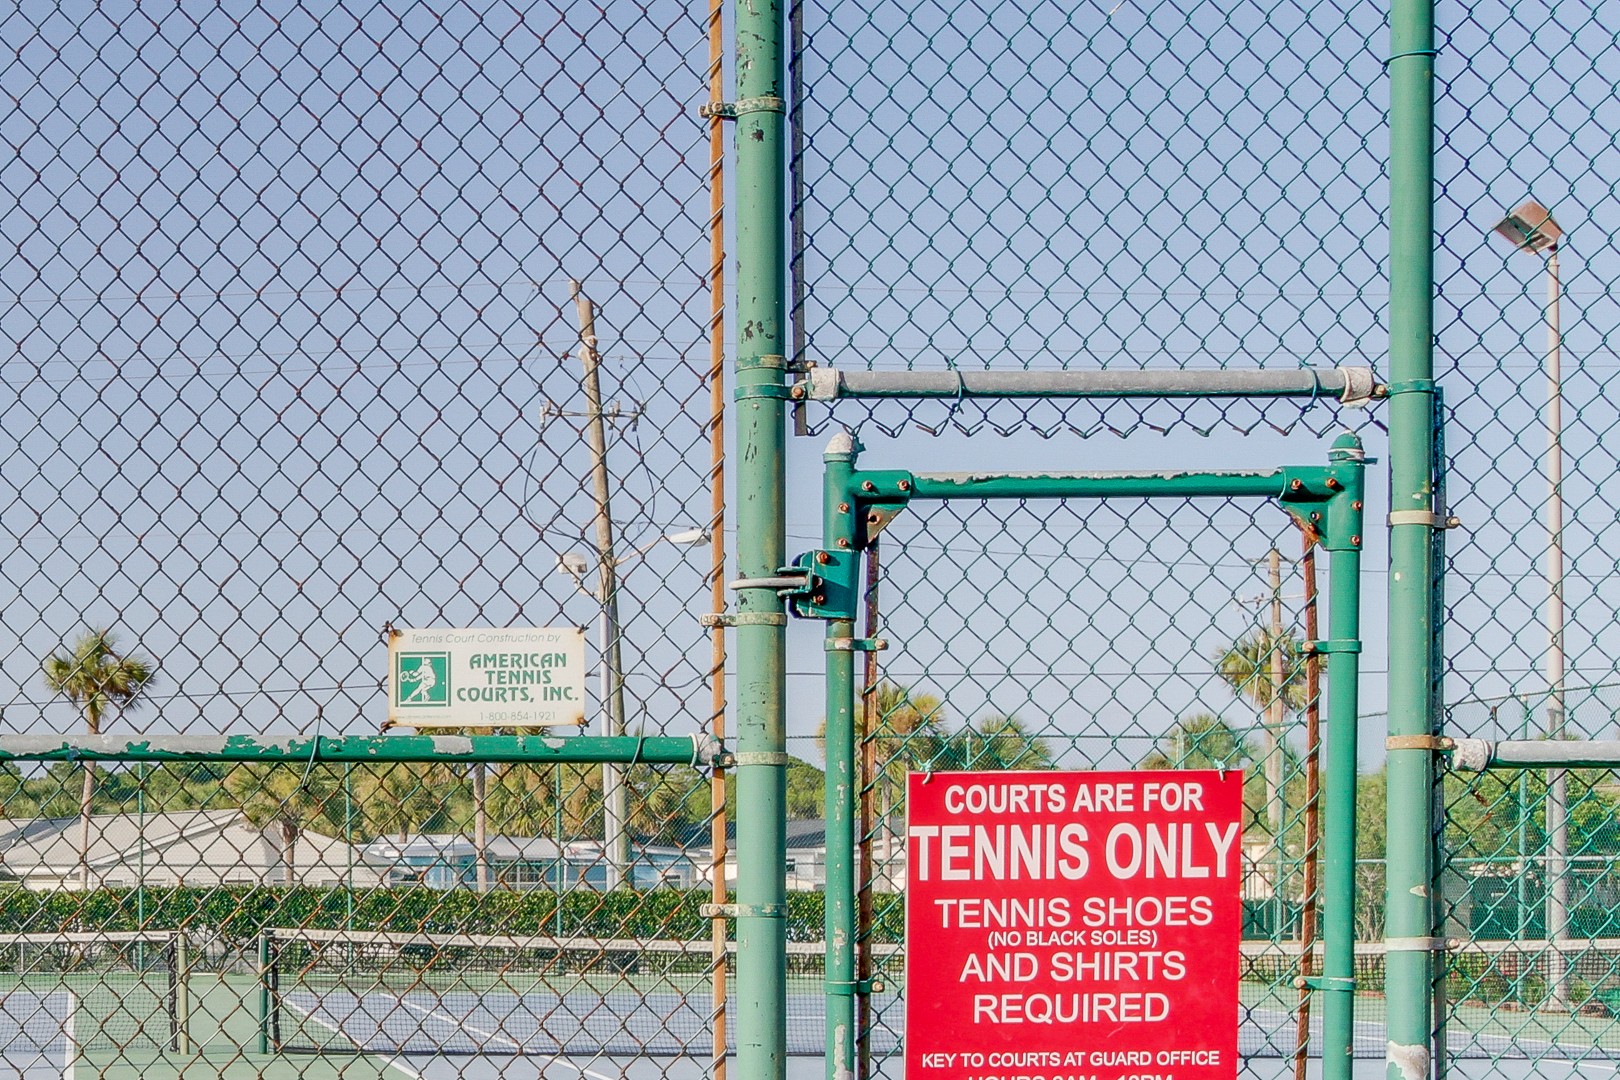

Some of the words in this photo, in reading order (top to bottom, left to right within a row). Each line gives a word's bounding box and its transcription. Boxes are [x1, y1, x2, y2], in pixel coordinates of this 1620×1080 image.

[411, 634, 443, 644] Tennis
[446, 634, 475, 643] Court
[477, 633, 544, 643] Construction
[547, 634, 561, 643] by
[470, 653, 567, 669] AMERICAN
[484, 670, 552, 685] TENNIS
[456, 687, 534, 703] COURTS,
[543, 686, 579, 701] INC.
[480, 712, 556, 720] 1-800-854-1921
[945, 785, 1065, 814] COURTS
[1073, 784, 1133, 812] ARE
[1143, 783, 1204, 811] FOR
[909, 823, 1090, 880] TENNIS
[1105, 822, 1239, 879] ONLY
[934, 898, 1071, 928] TENNIS
[1082, 896, 1213, 926] SHOES
[987, 932, 1021, 949] (NO
[1026, 932, 1086, 946] BLACK
[1090, 930, 1158, 948] SOLES)
[959, 953, 1038, 982] AND
[1050, 951, 1186, 981] SHIRTS
[974, 993, 1170, 1024] REQUIRED
[922, 1054, 957, 1067] KEY
[960, 1054, 984, 1067] TO
[988, 1053, 1061, 1067] COURTS
[1064, 1052, 1086, 1066] AT
[1089, 1052, 1152, 1066] GUARD
[1156, 1051, 1220, 1065] OFFICE
